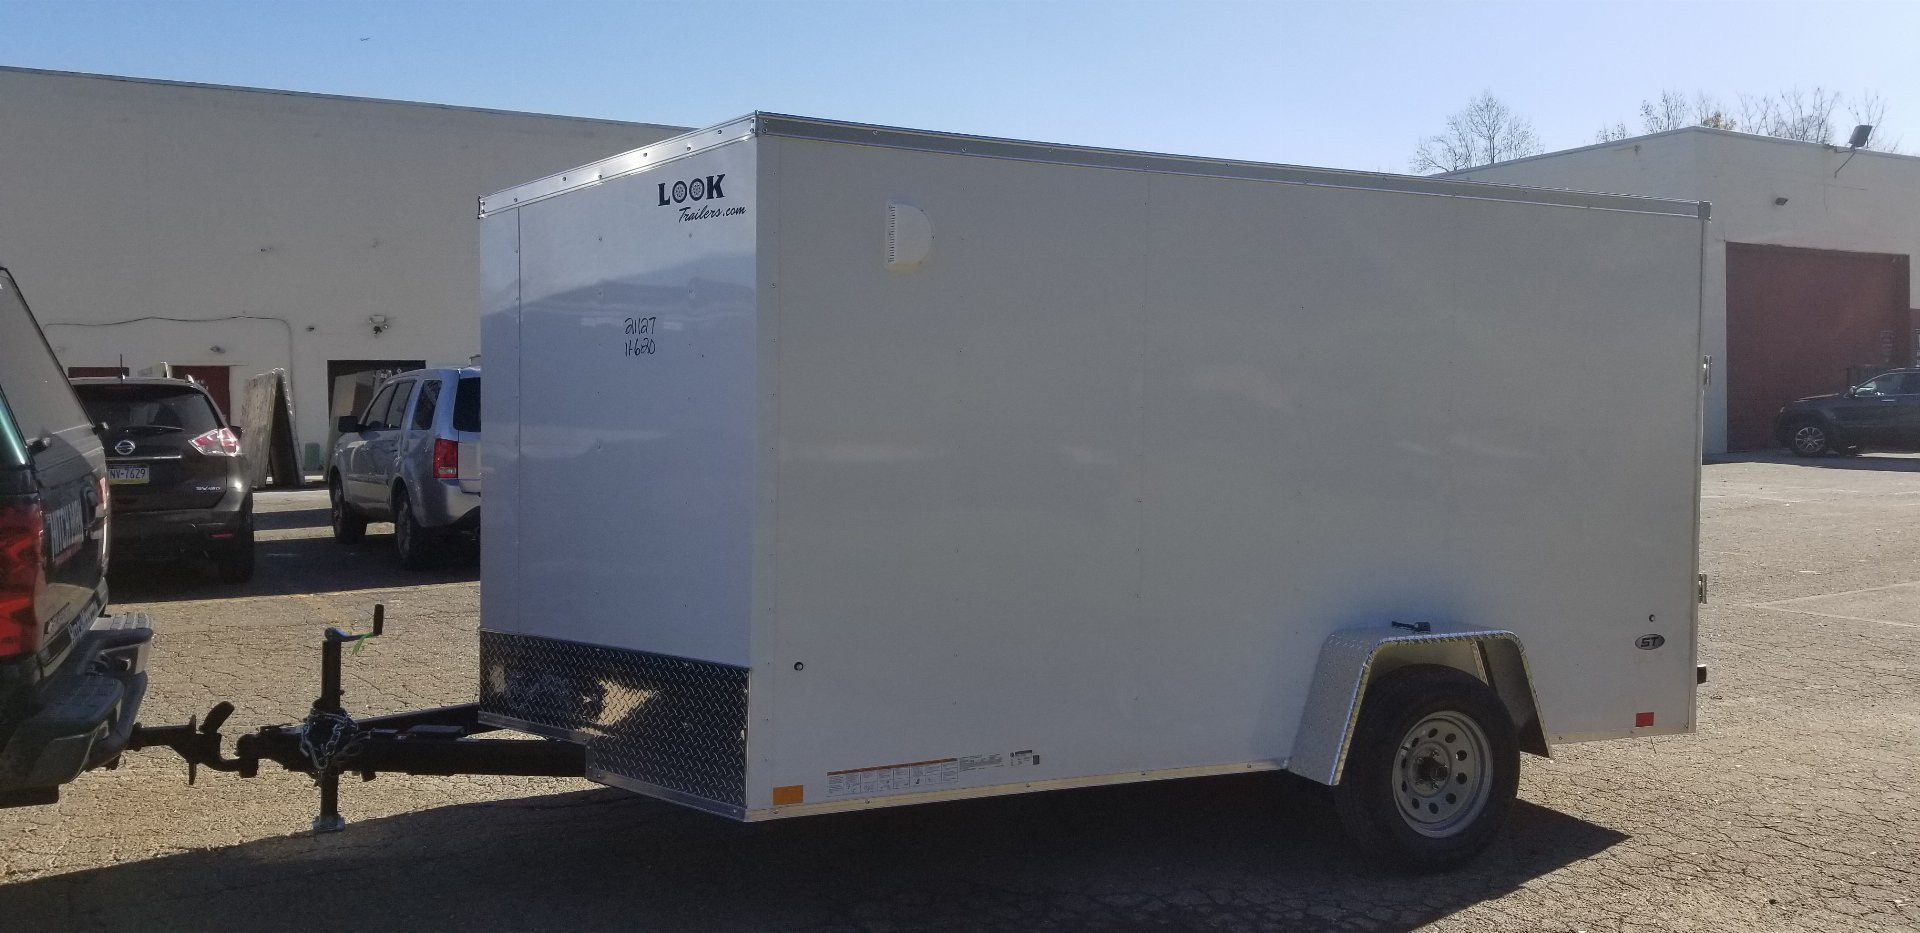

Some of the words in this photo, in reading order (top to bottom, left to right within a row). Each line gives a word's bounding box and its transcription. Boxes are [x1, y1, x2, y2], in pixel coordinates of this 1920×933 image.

[658, 174, 725, 206] LOOK
[679, 205, 746, 223] Trailers.com
[110, 468, 146, 479] NV-7629
